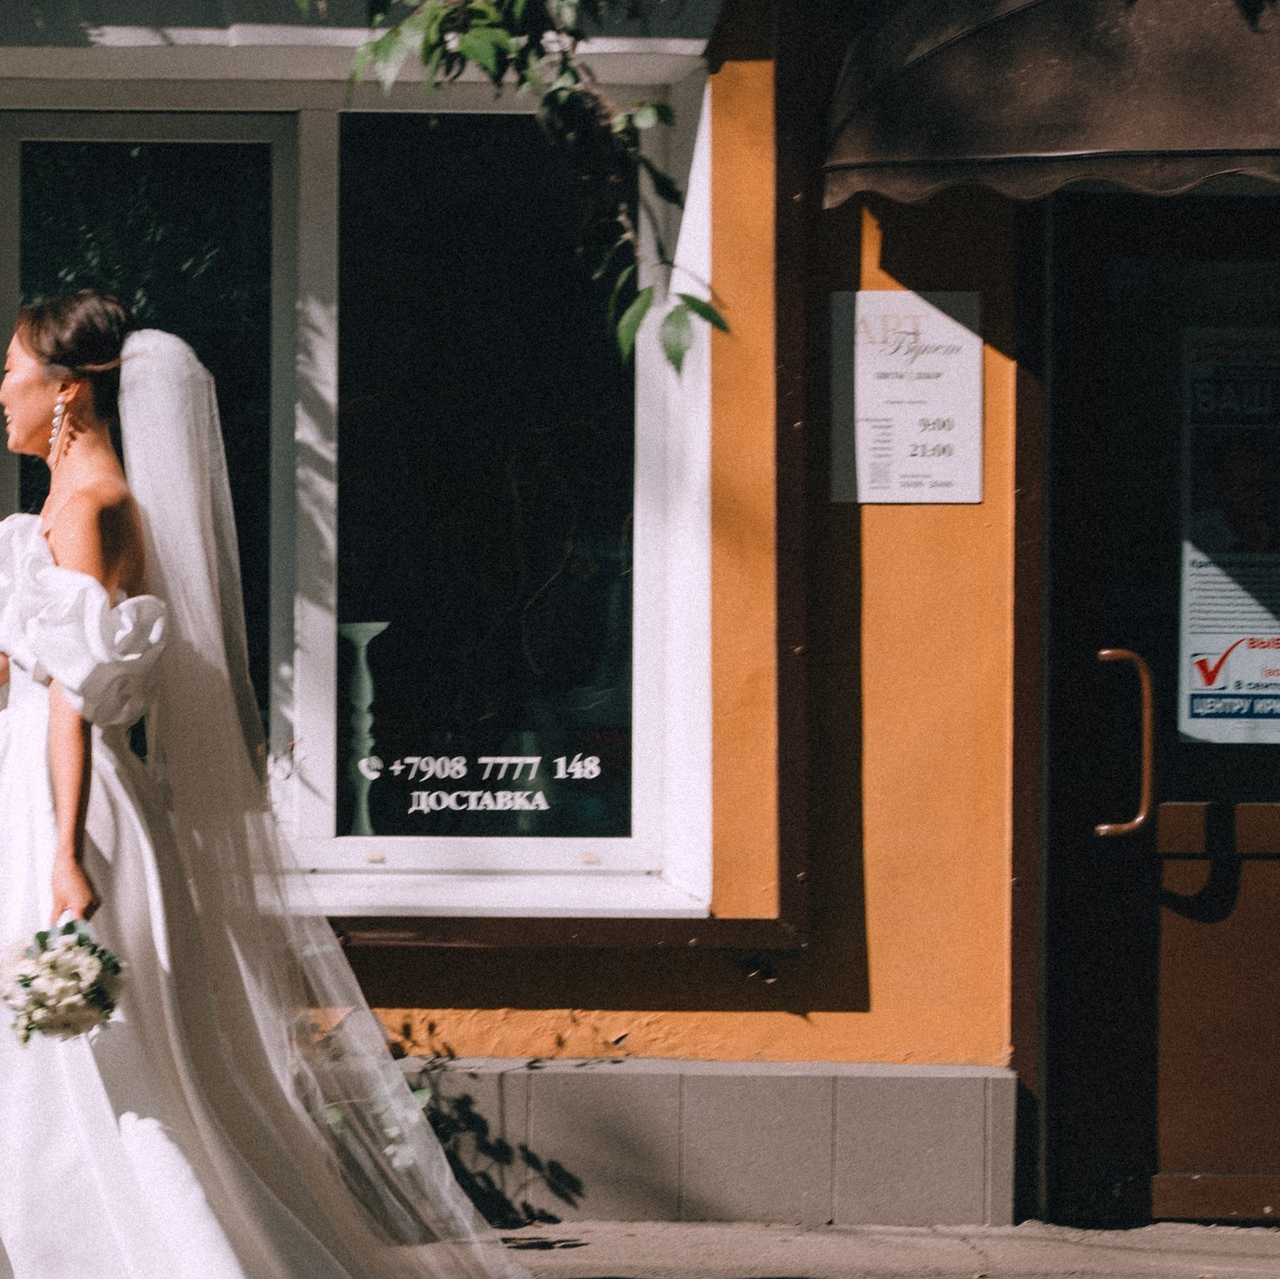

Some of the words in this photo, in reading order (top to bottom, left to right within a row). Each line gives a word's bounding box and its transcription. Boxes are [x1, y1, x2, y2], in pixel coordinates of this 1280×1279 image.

[388, 755, 468, 782] +7908
[477, 755, 543, 781] 7777
[552, 752, 602, 780] 148
[407, 789, 551, 815] ДОСТАВКА
